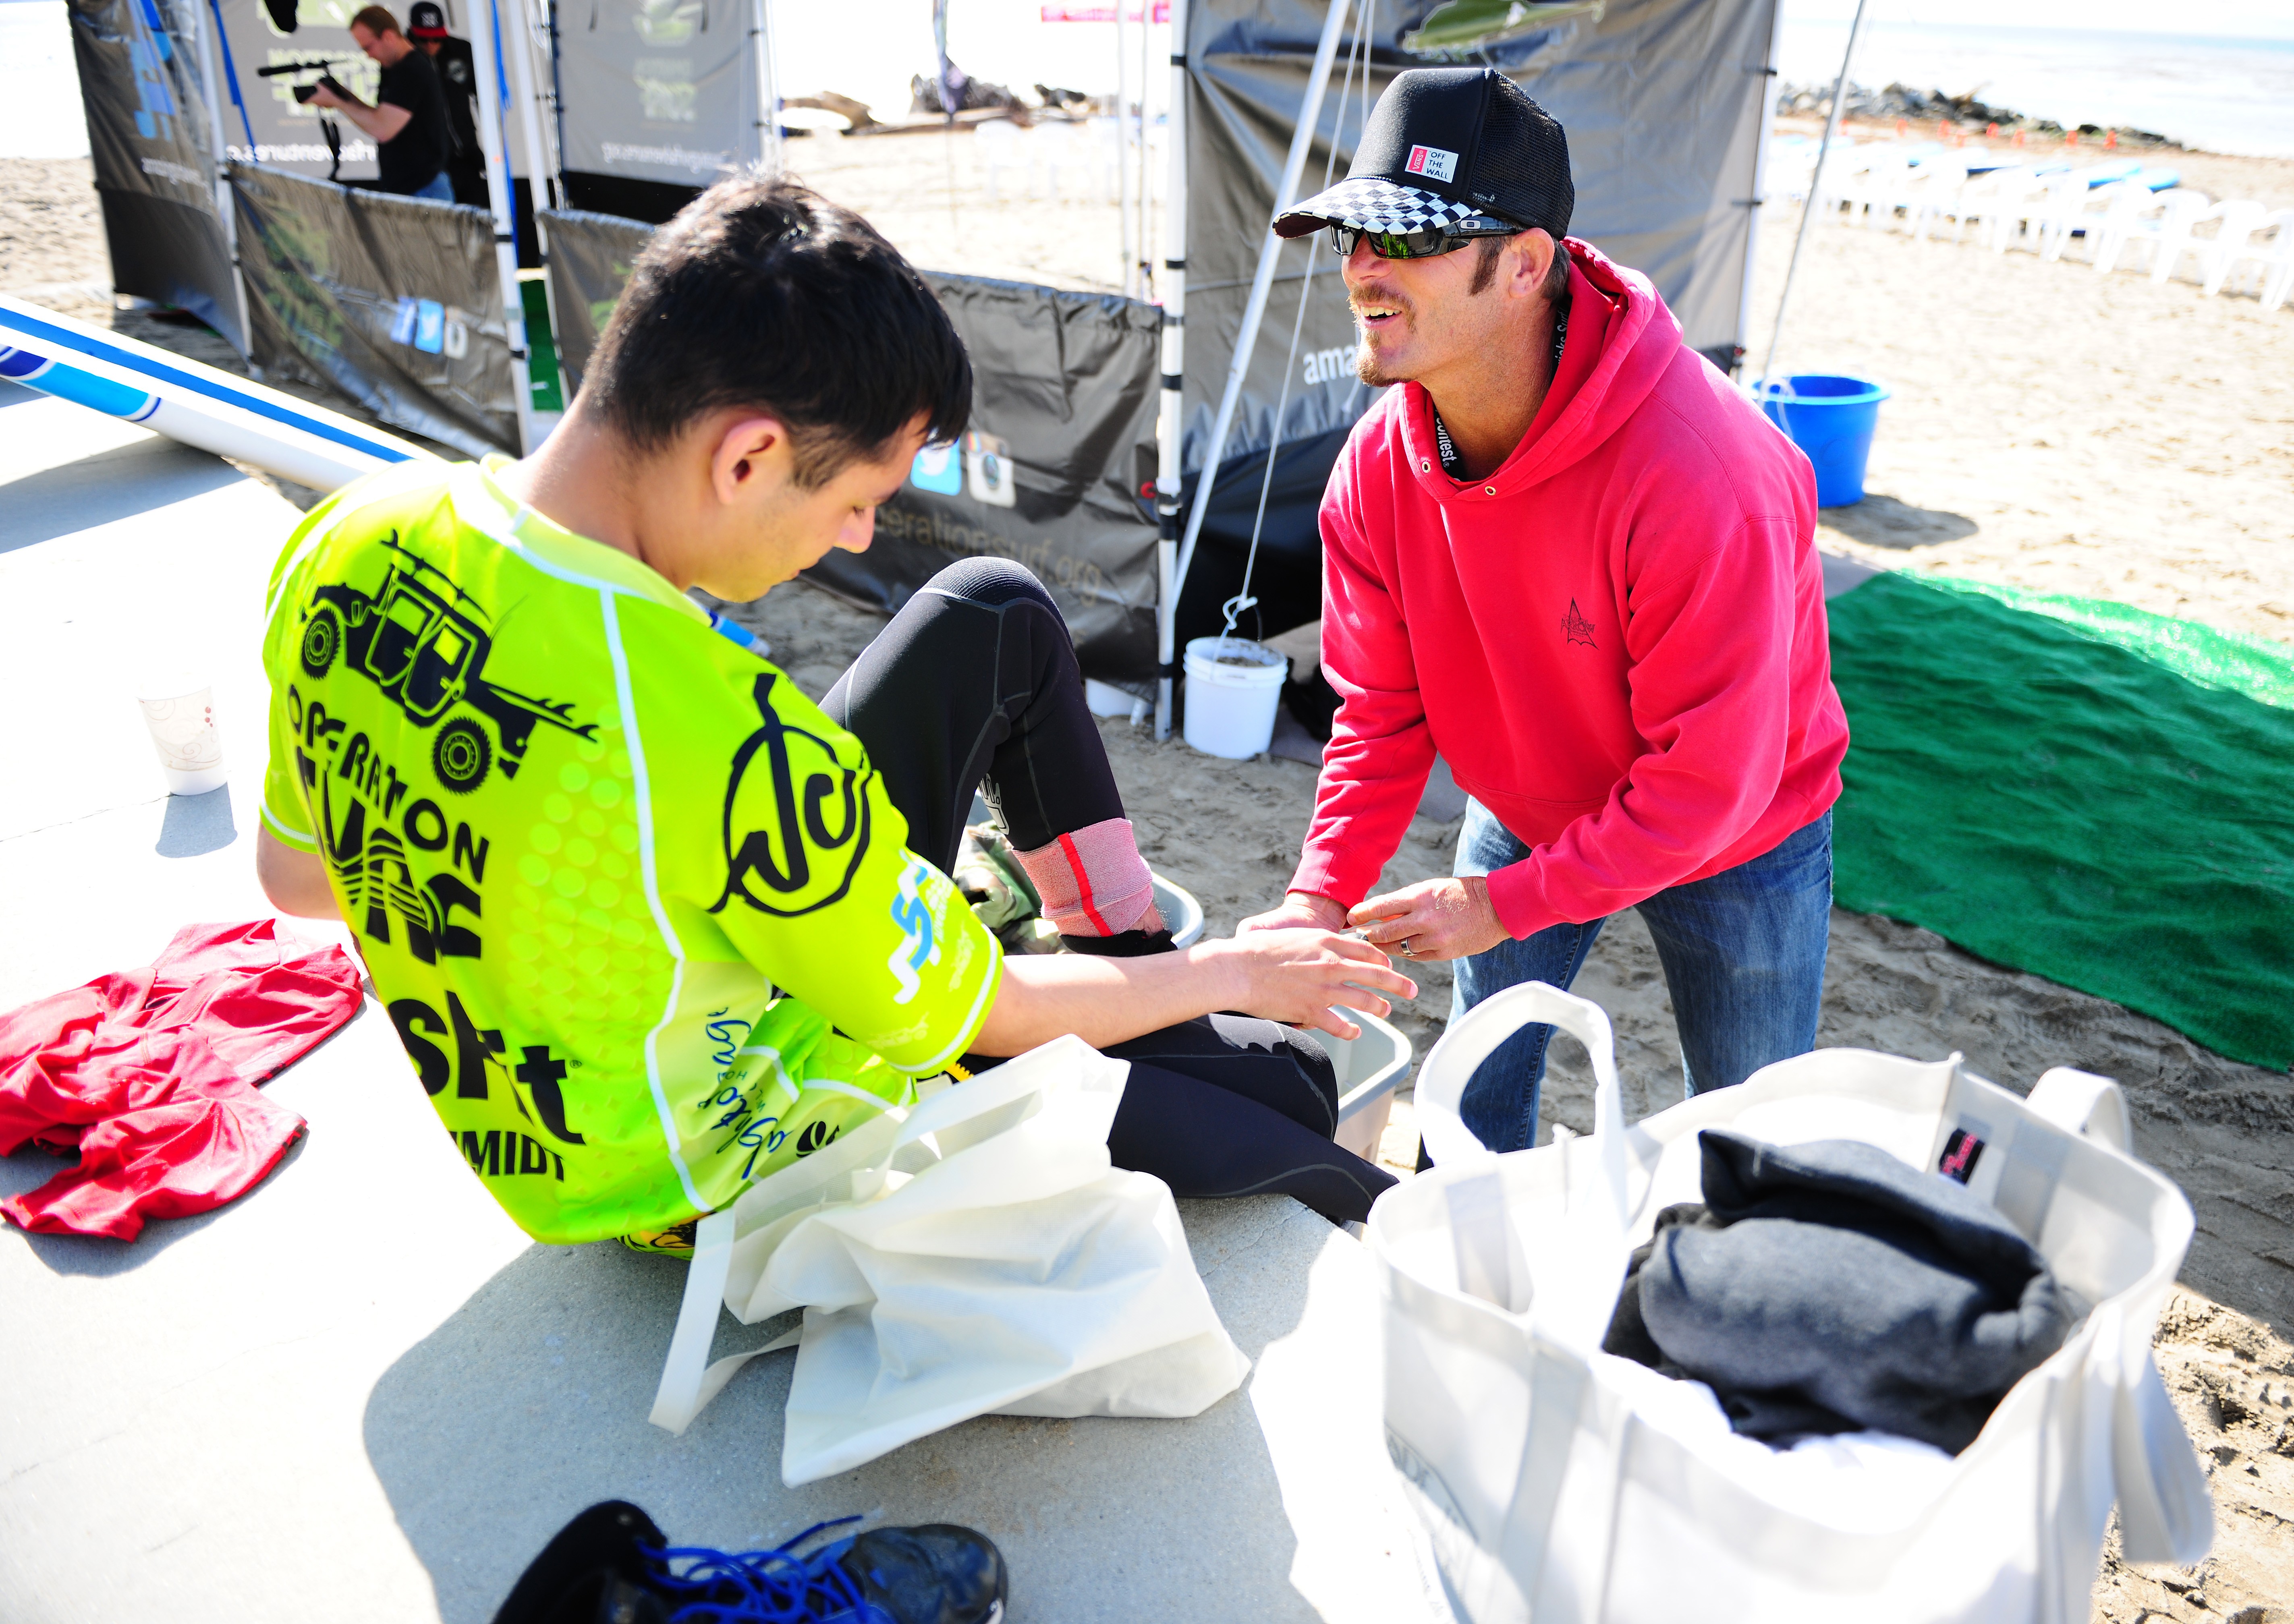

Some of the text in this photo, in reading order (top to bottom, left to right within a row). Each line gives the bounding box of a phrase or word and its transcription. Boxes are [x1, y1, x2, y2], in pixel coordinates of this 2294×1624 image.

[1429, 160, 1443, 168] THE
[1427, 168, 1448, 179] WALL
[288, 684, 489, 885] OPERATON
